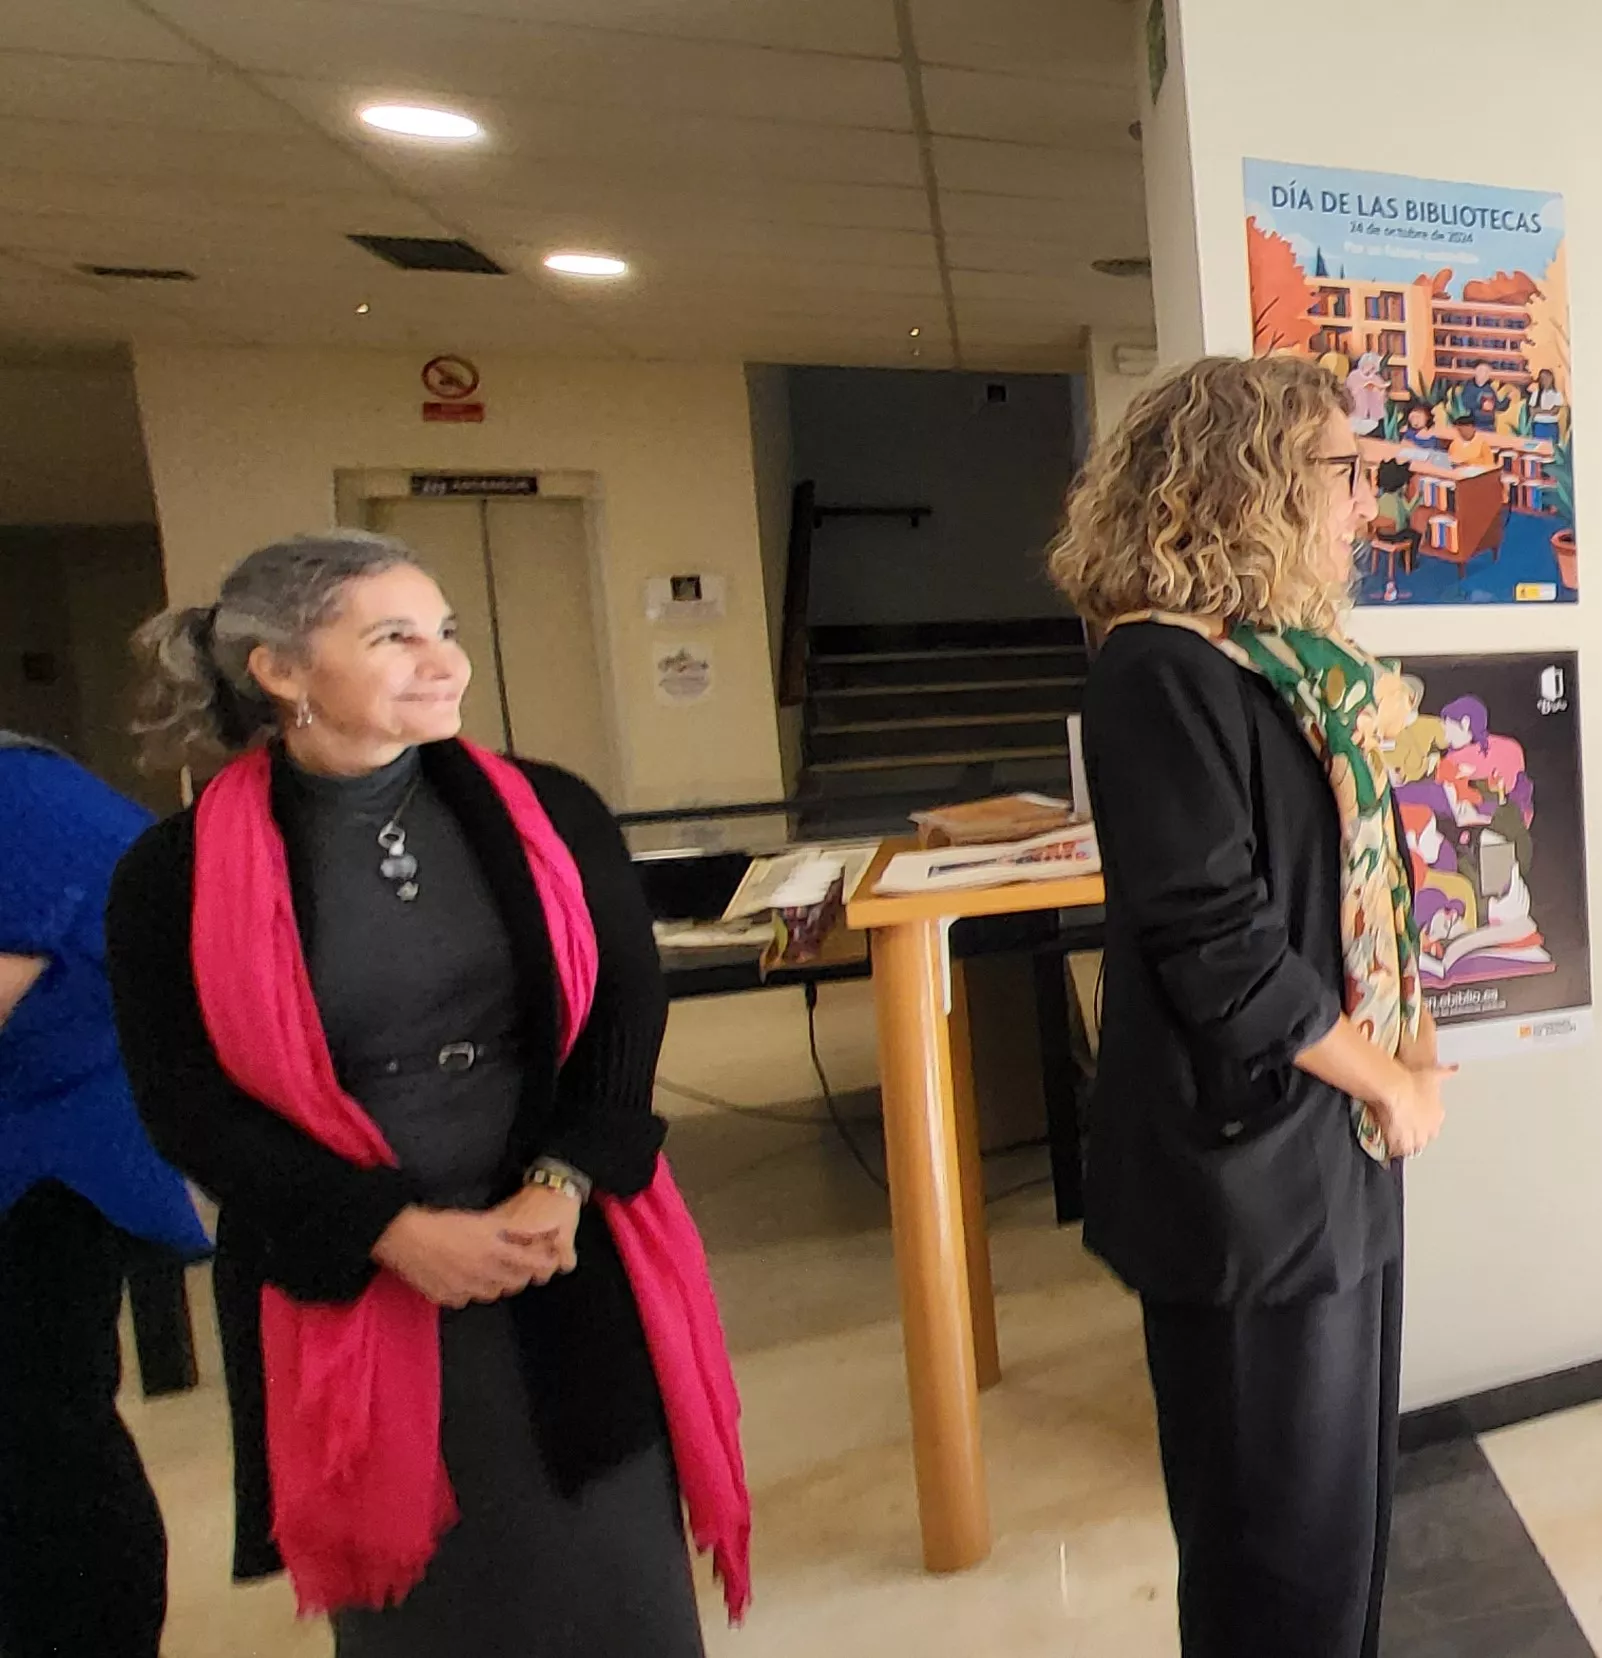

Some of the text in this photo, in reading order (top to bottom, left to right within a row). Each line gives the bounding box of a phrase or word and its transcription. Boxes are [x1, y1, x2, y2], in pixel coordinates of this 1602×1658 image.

[1271, 180, 1543, 234] DÍA DE LAS BIBLIOTECAS
